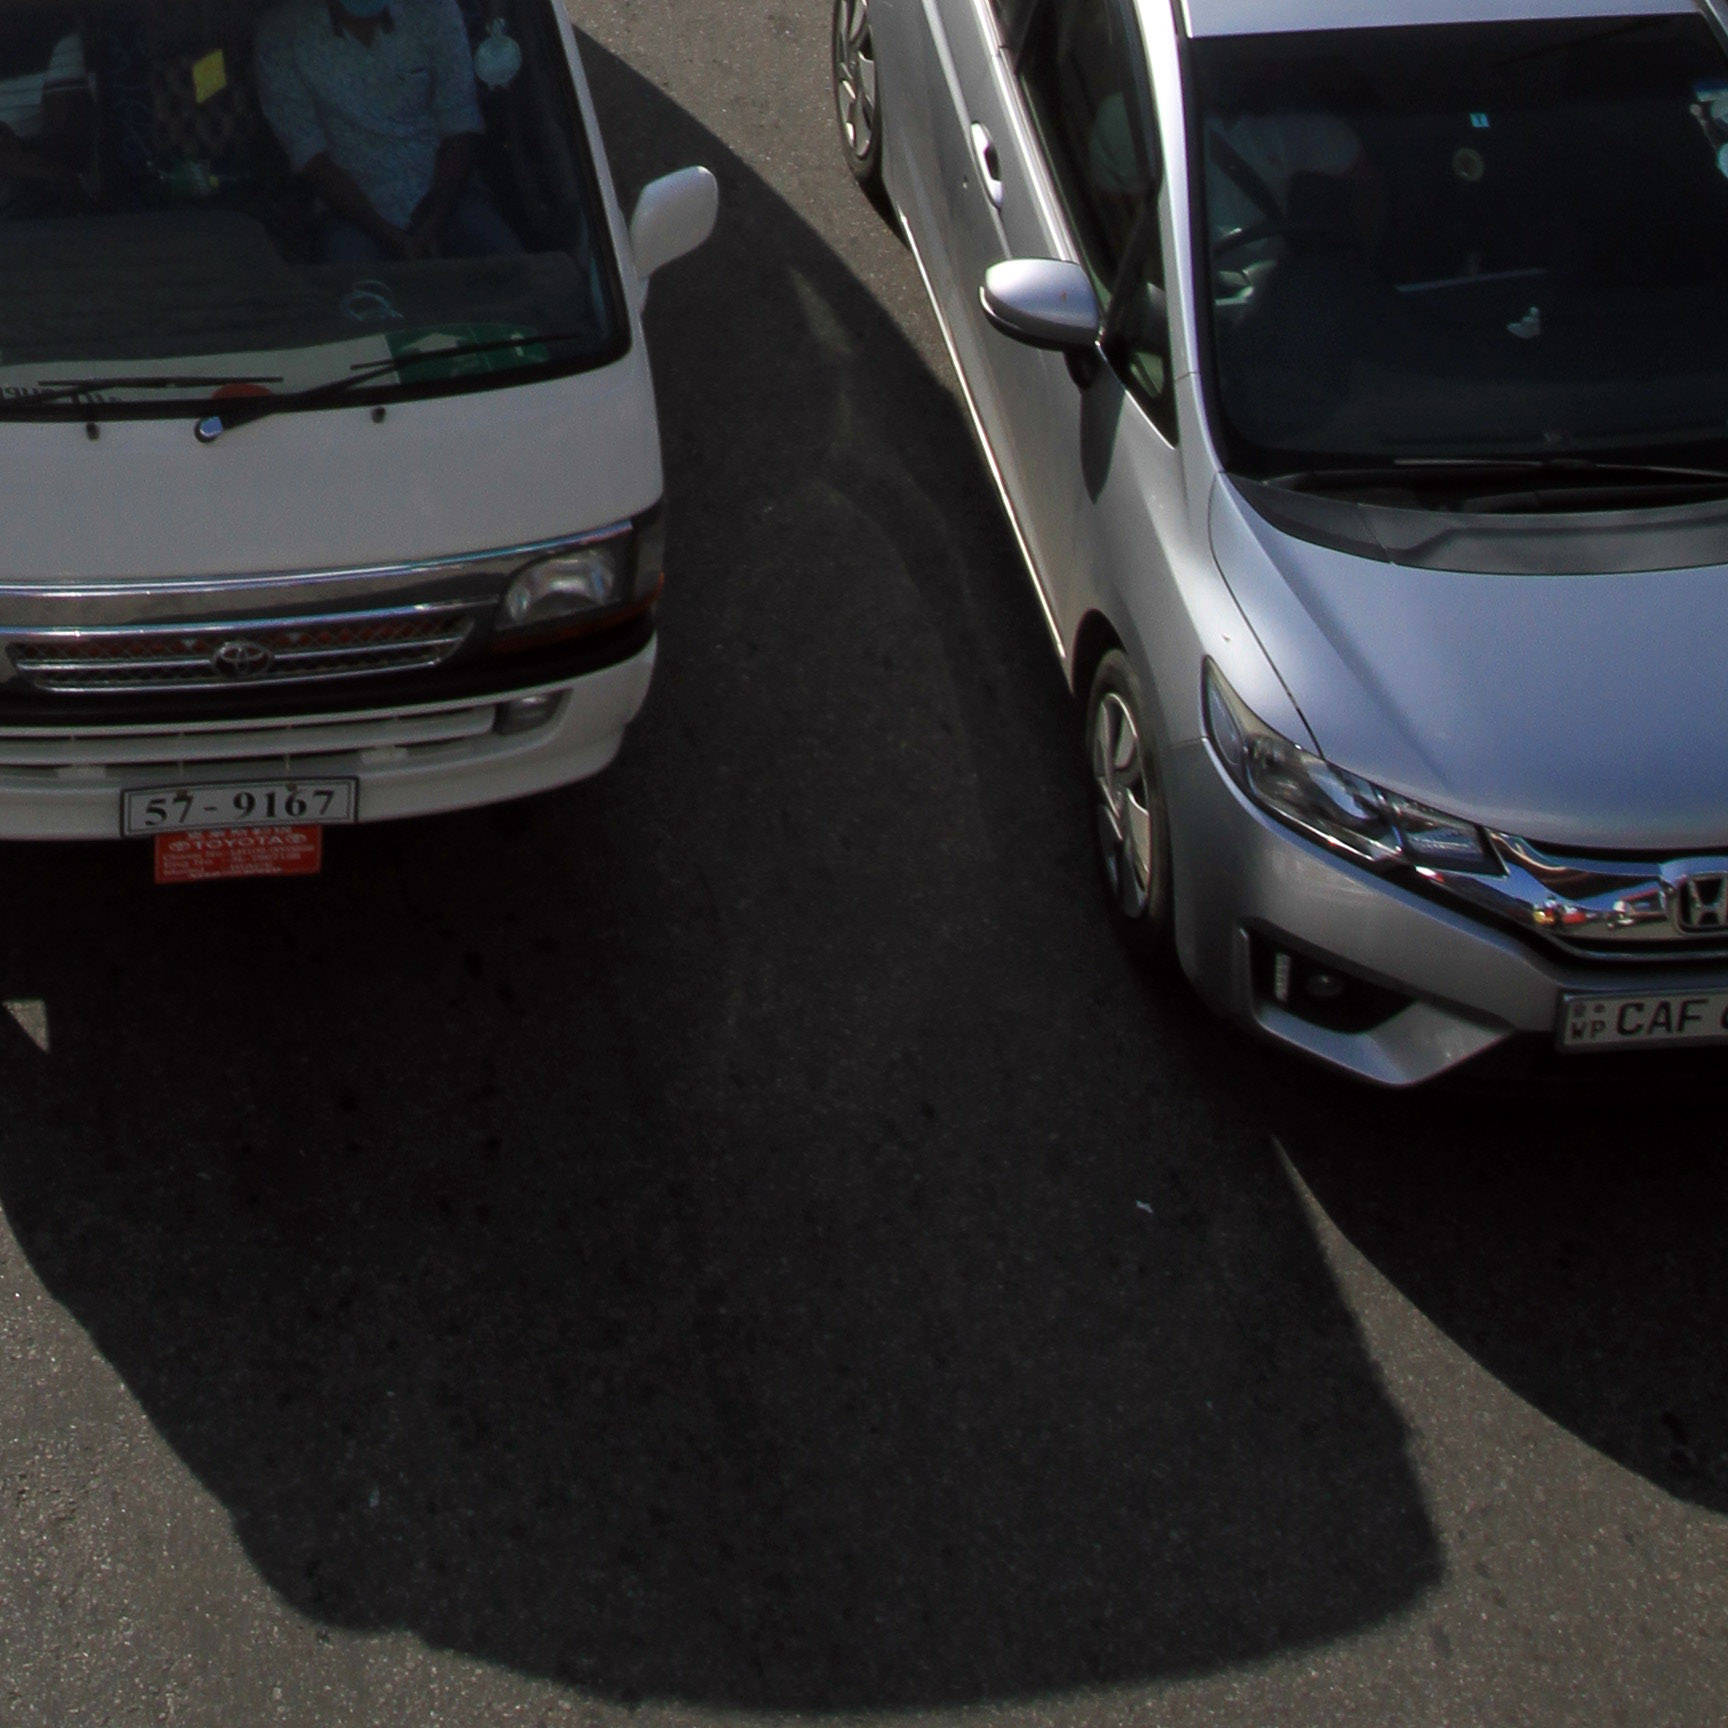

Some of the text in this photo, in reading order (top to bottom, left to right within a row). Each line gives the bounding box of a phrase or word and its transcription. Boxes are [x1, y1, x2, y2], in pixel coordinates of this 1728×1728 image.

[144, 794, 194, 826] 57
[232, 789, 334, 819] 9167
[195, 836, 284, 850] TOYOTA
[1572, 999, 1710, 1039] WP CAF
